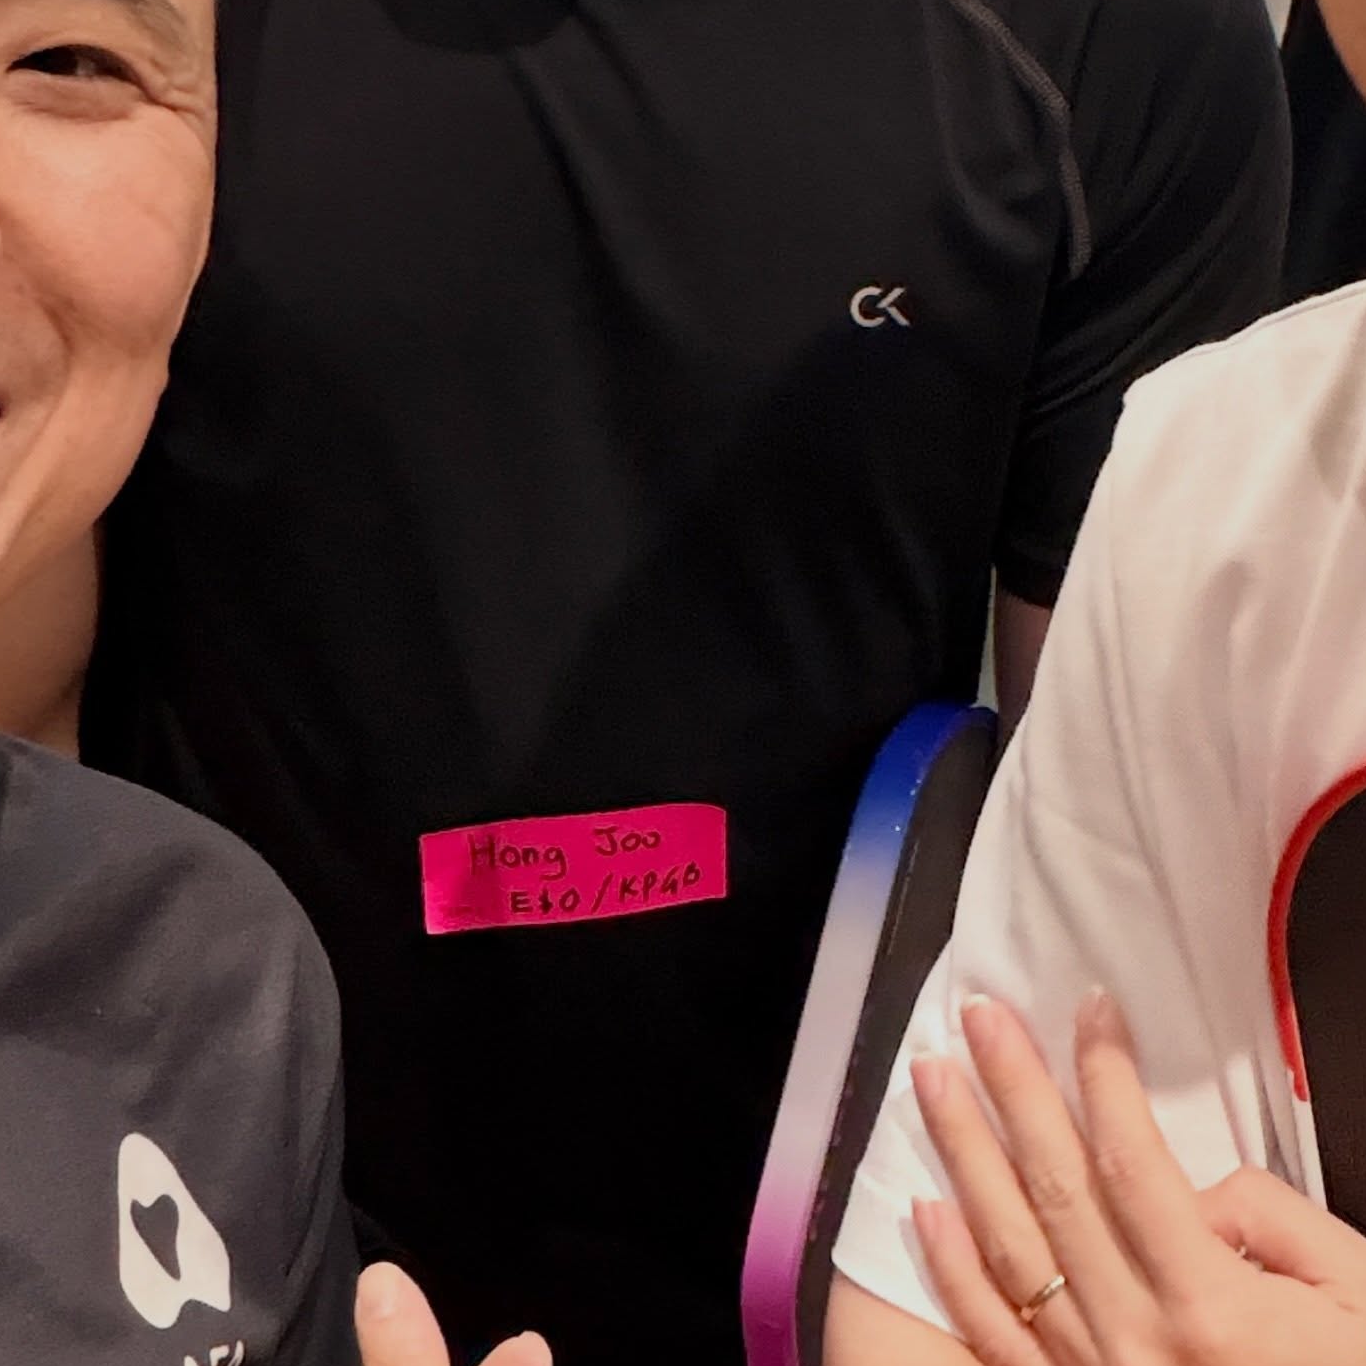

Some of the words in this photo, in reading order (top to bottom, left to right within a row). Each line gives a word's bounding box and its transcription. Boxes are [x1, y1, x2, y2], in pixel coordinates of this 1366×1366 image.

[850, 286, 911, 327] CK
[469, 833, 567, 881] Hong
[593, 824, 662, 857] Joo
